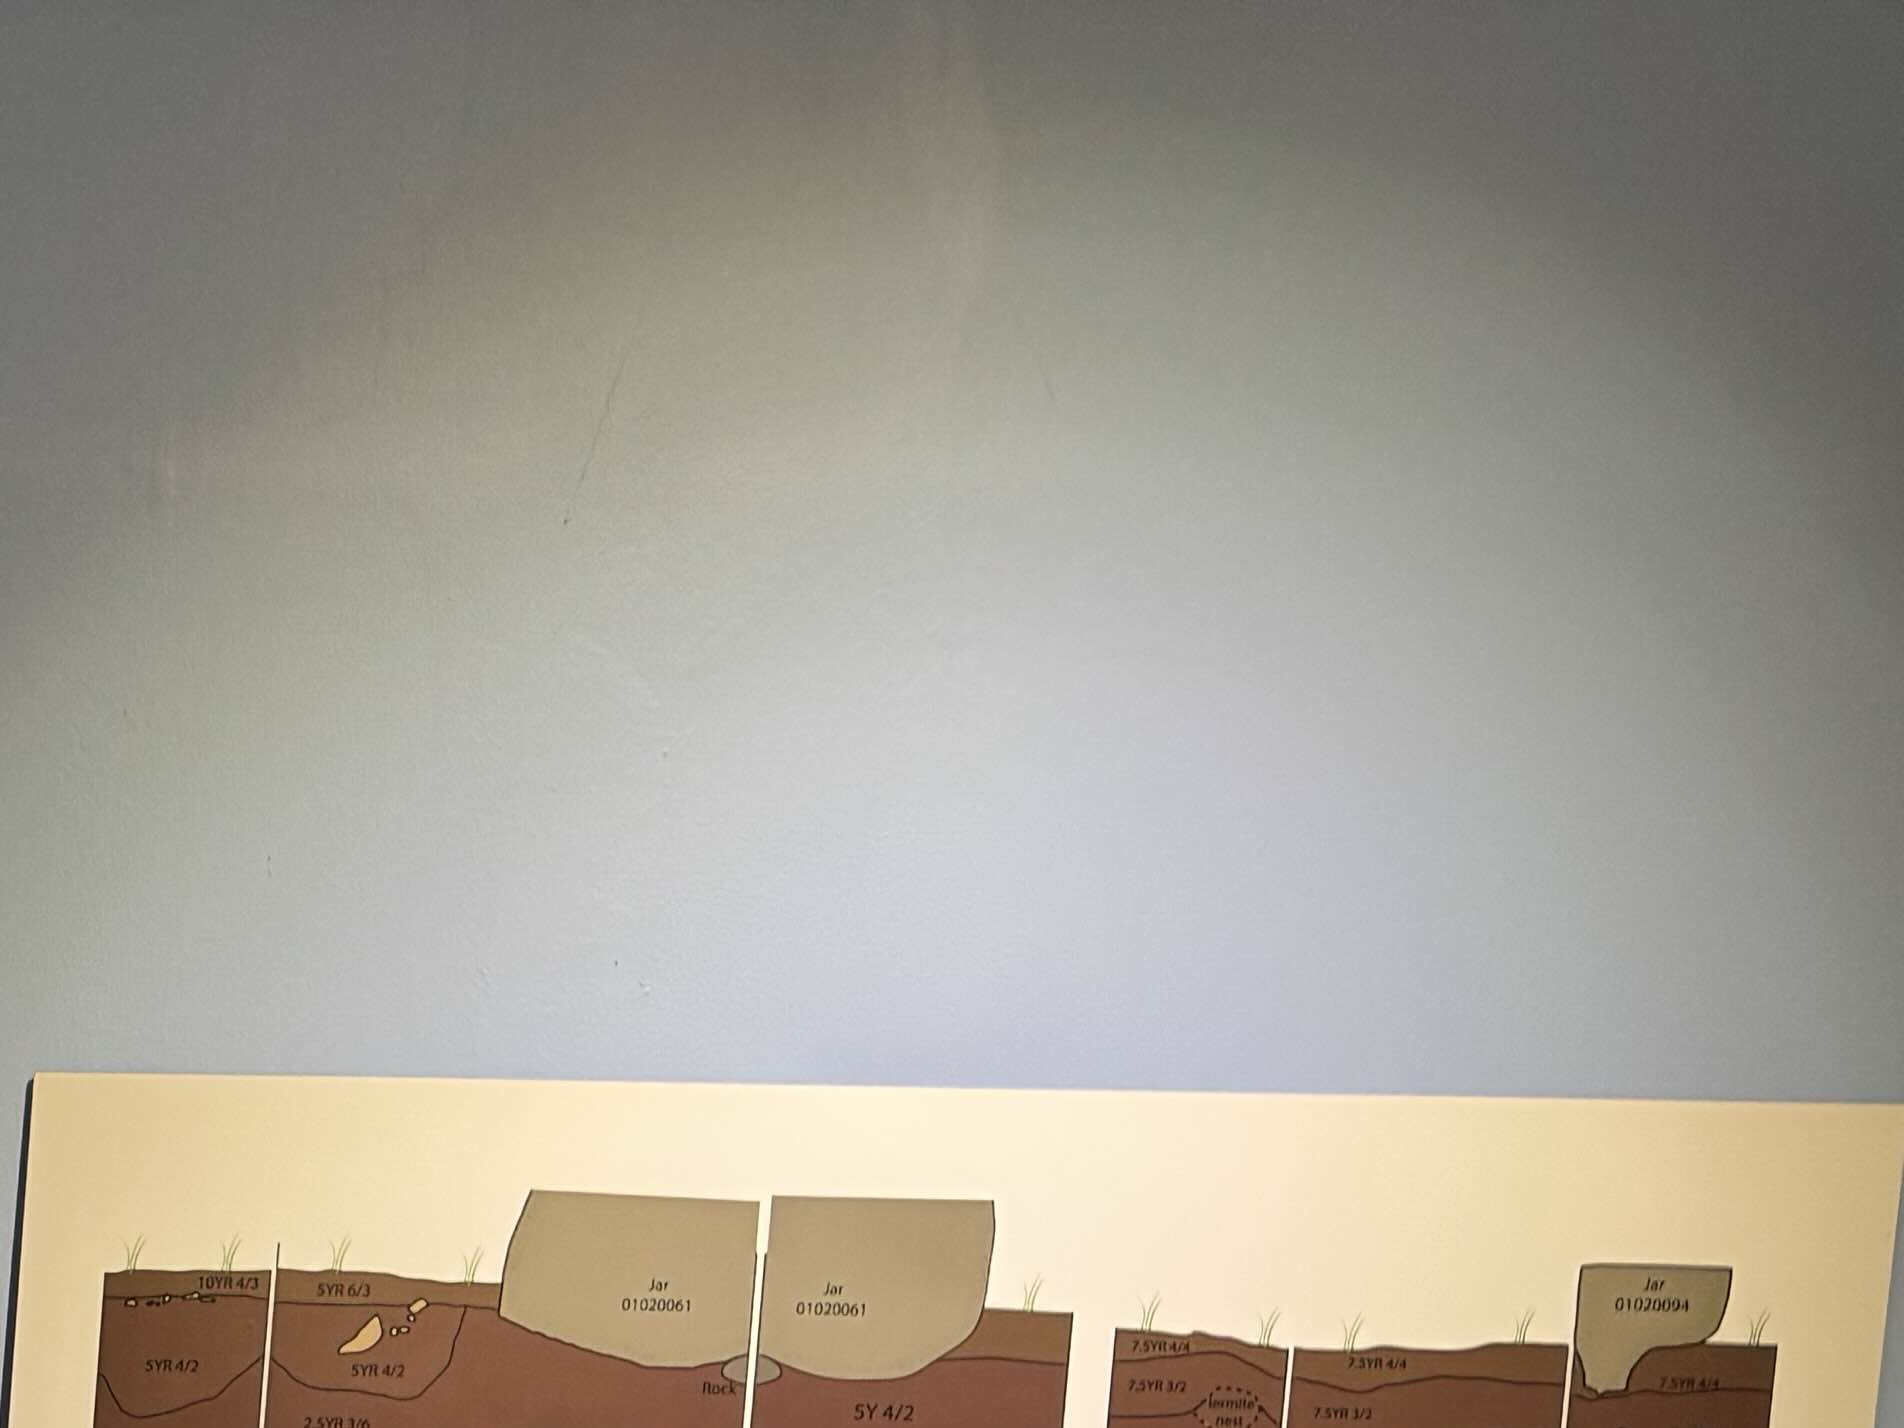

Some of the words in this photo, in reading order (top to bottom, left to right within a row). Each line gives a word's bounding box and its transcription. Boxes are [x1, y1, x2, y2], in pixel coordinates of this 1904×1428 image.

[200, 1276, 232, 1289] 10YR
[236, 1277, 259, 1290] 4/3
[318, 1283, 344, 1296] 5YR
[348, 1284, 370, 1297] 6/3
[649, 1279, 668, 1291] Jar
[824, 1283, 843, 1295] Jar
[1645, 1278, 1664, 1291] Jar
[622, 1298, 690, 1312] 01020061
[796, 1302, 865, 1316] 01020061
[146, 1359, 171, 1372] 5YR
[175, 1360, 198, 1372] 4/2
[855, 1404, 878, 1420] 5Y
[883, 1405, 914, 1421] 4/2
